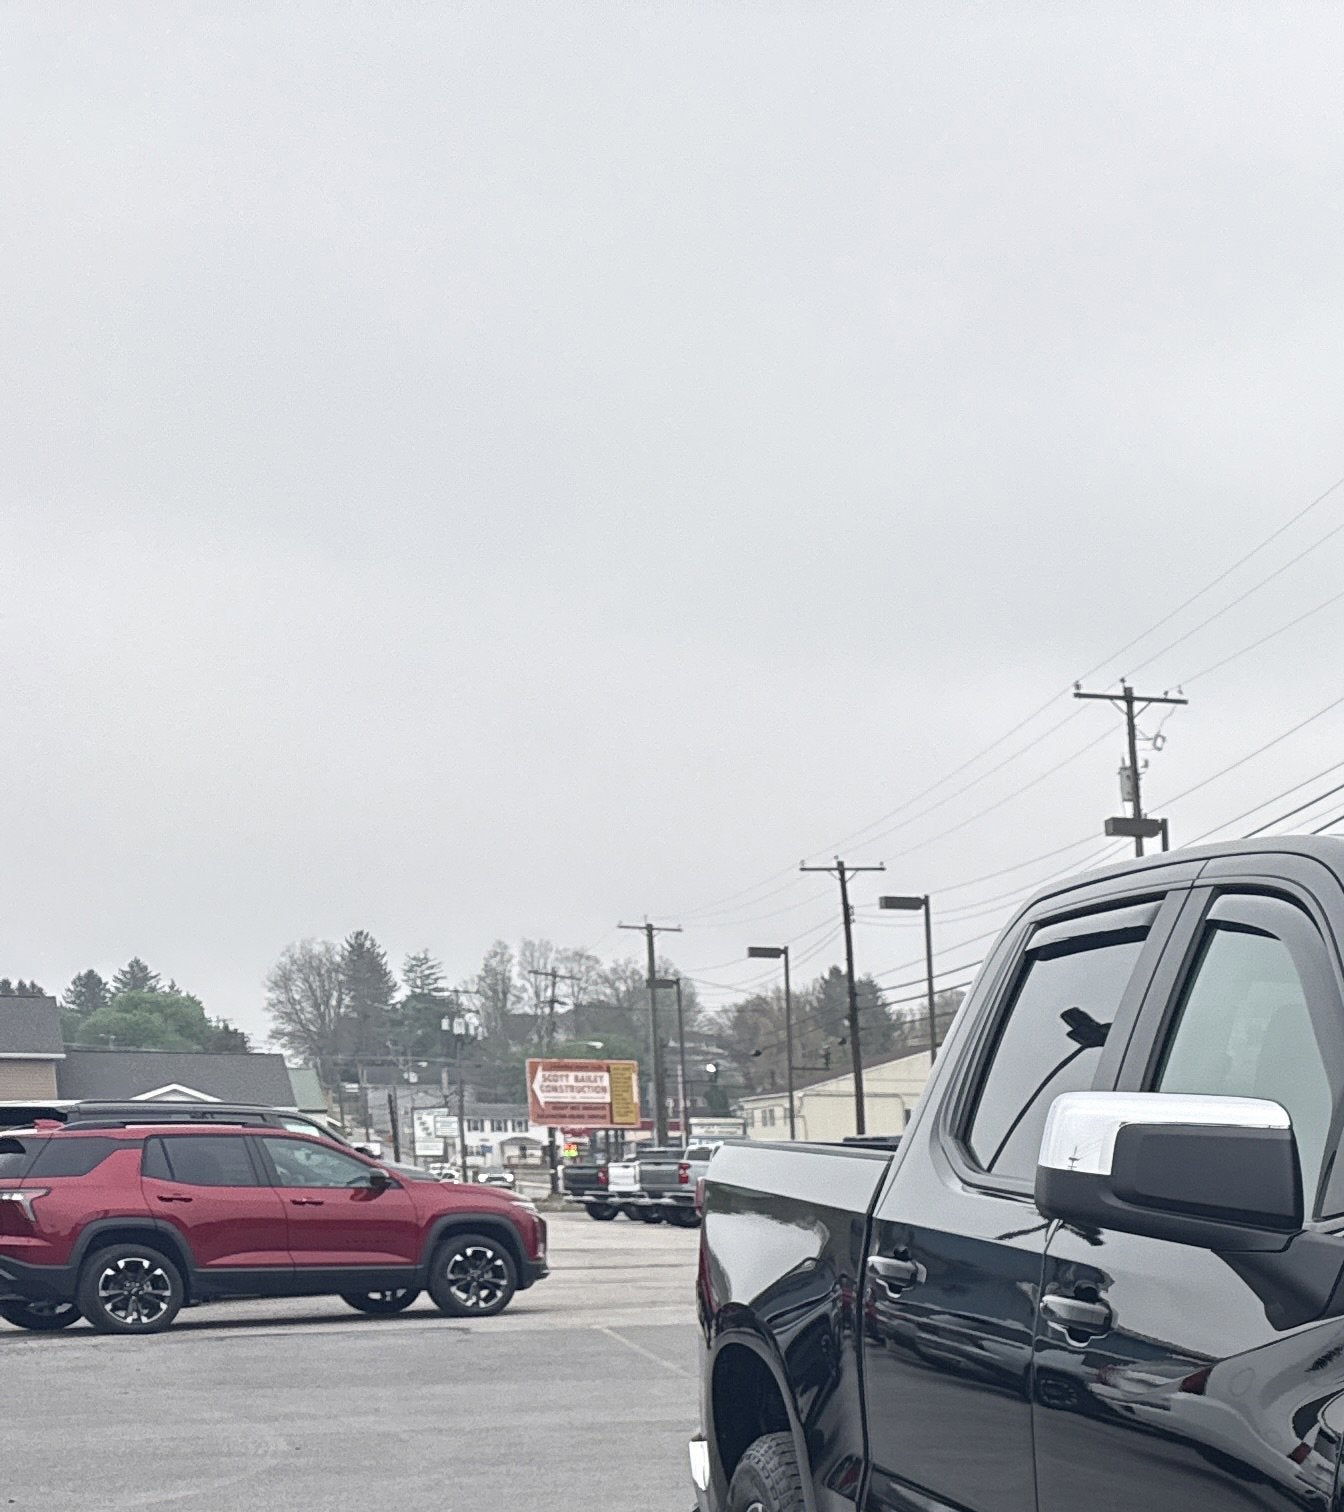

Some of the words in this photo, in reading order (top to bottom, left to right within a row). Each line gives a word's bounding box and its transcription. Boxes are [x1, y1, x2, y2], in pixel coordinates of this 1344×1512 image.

[542, 1073, 570, 1083] SCOTT
[574, 1074, 605, 1084] BAILEY
[540, 1084, 608, 1094] CONSTRUCTION
